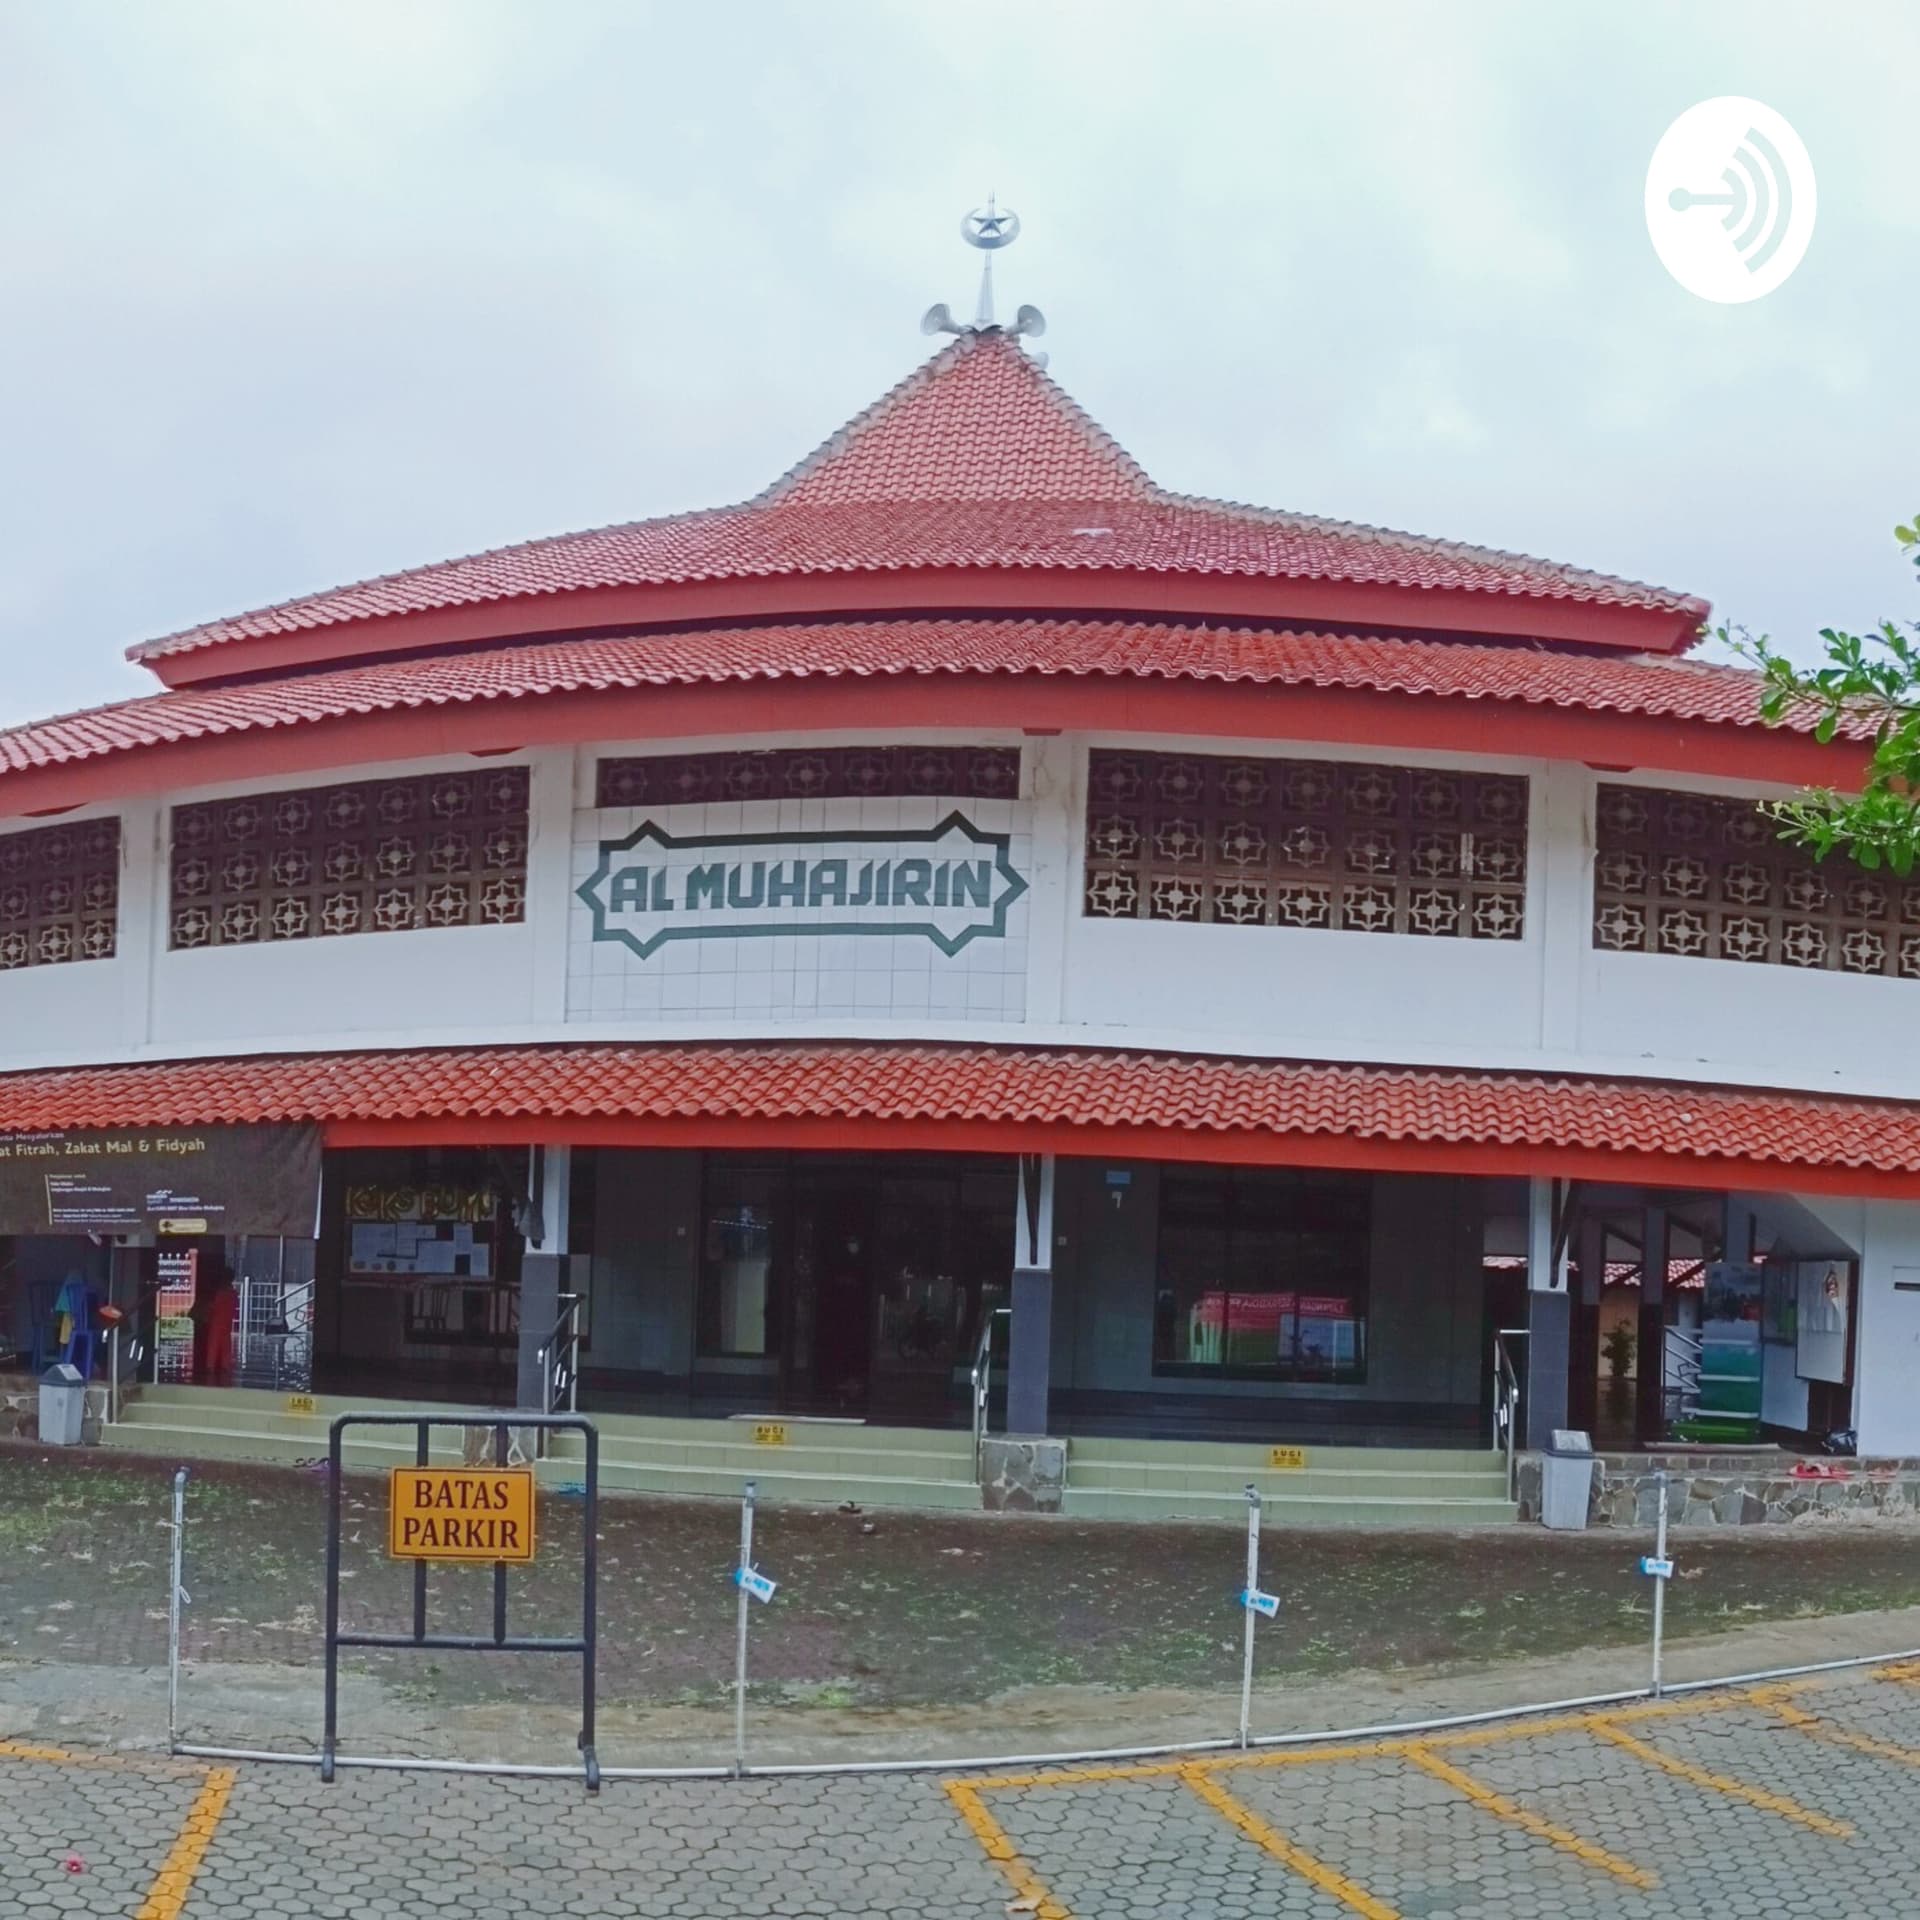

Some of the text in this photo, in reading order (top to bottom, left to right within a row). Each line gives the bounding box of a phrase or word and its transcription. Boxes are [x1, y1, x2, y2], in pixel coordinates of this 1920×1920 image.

[609, 858, 992, 913] AL MUHAJIRIN
[16, 1143, 60, 1157] Fitrah,
[65, 1141, 101, 1154] Zakat
[106, 1140, 133, 1153] Mal
[138, 1140, 149, 1152] &
[156, 1137, 206, 1155] Fidyah
[414, 1479, 509, 1511] BATAS
[402, 1517, 520, 1549] PARKIR
